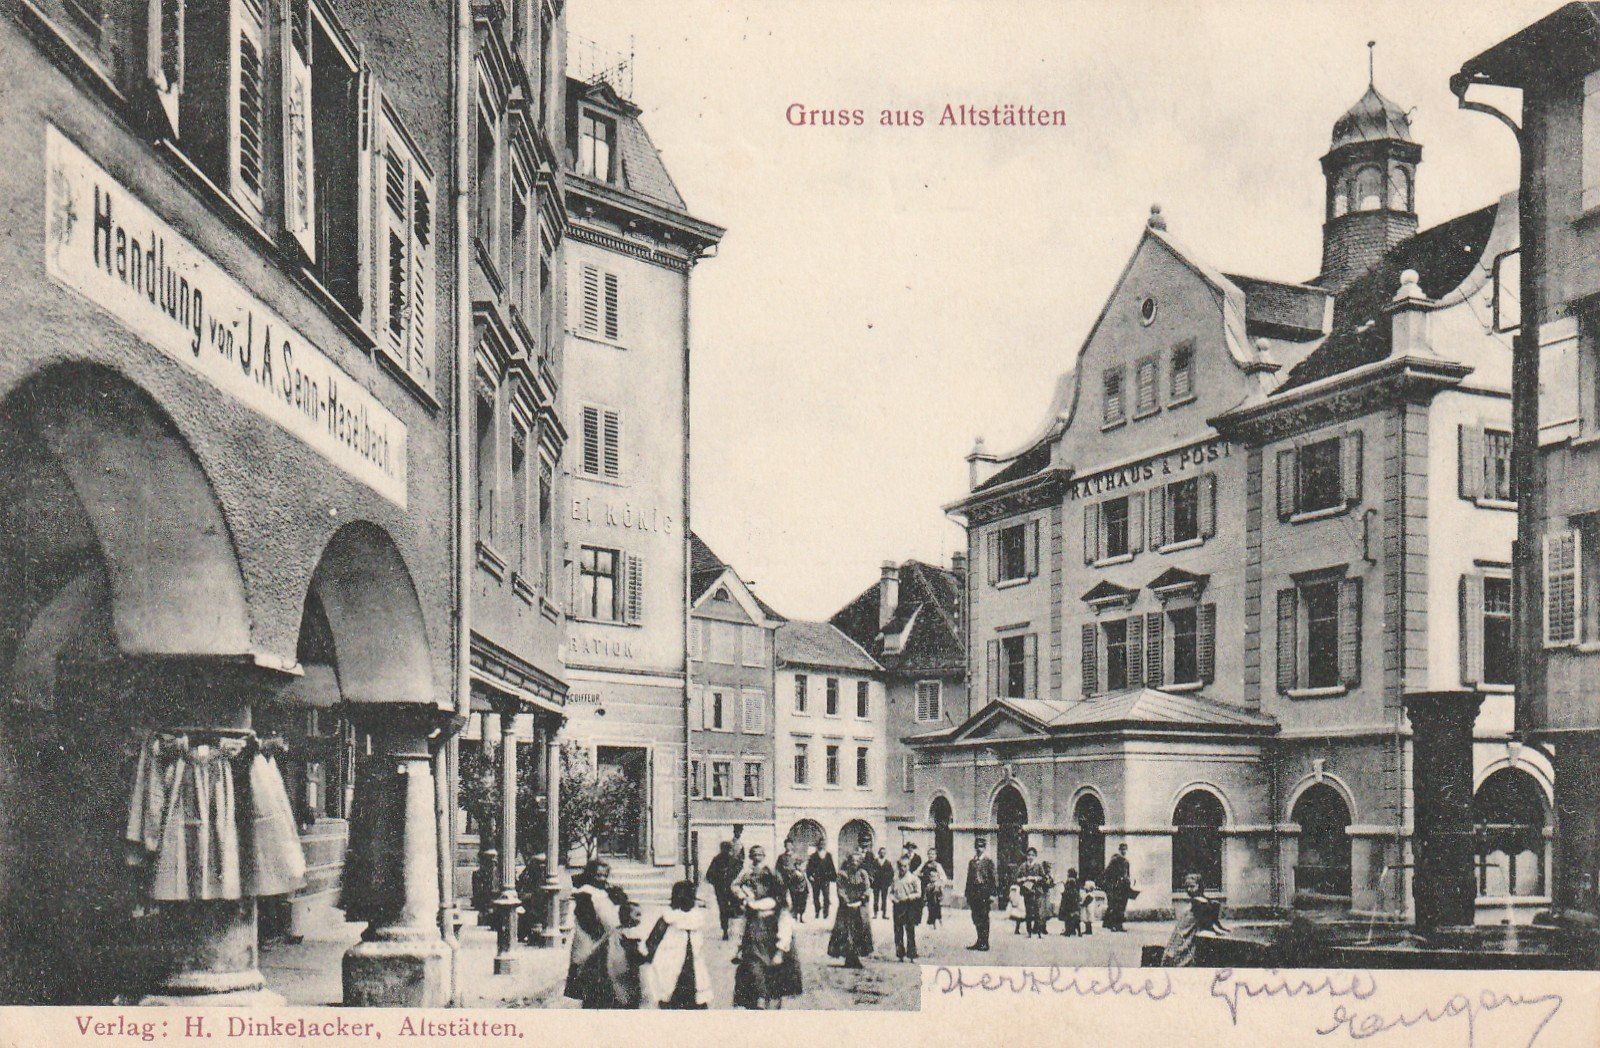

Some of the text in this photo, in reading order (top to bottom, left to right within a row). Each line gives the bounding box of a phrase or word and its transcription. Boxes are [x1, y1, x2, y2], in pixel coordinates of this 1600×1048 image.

[93, 184, 203, 358] Handlung
[208, 314, 234, 362] von
[1071, 440, 1231, 501] RATHAUS & POST
[934, 954, 1173, 1001] Herzliche
